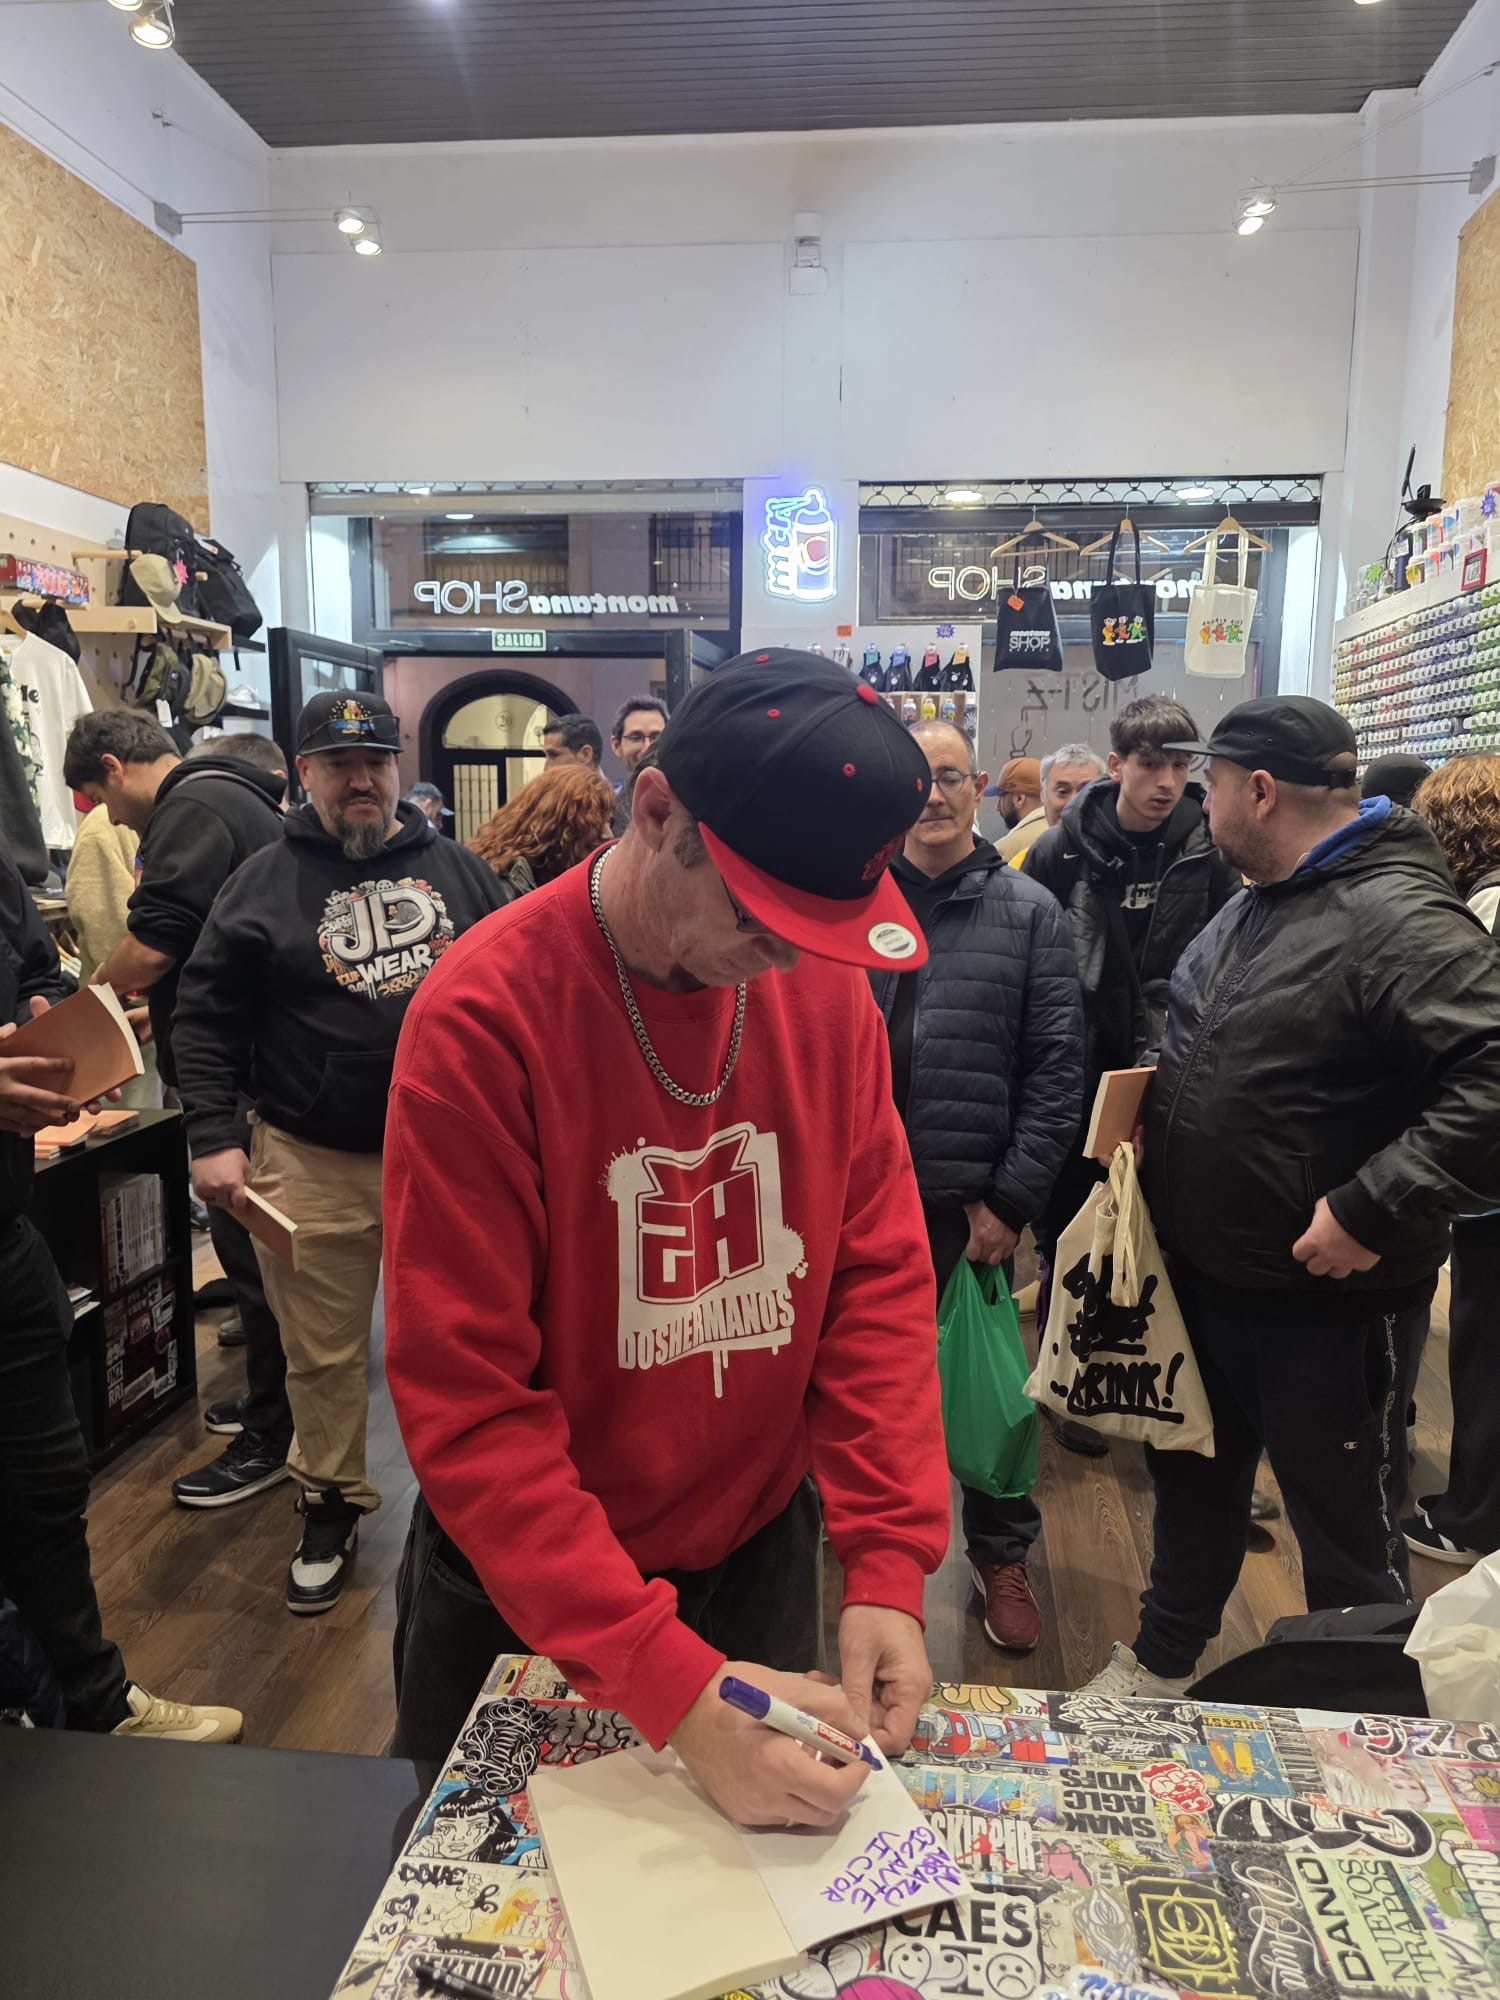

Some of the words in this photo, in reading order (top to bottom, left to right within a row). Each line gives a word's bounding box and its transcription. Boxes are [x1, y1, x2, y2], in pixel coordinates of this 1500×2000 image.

[496, 633, 541, 647] SALIDA
[1009, 636, 1051, 649] SHOP
[356, 943, 434, 986] WEAR
[620, 1286, 796, 1370] DOSHERMANOS
[1058, 1767, 1145, 1791] VDFS
[1063, 1790, 1148, 1814] AGLC
[1064, 1812, 1157, 1839] SNAK
[820, 1831, 900, 1903] VICTOR
[1338, 1858, 1420, 1984] NUEVOS
[1365, 1859, 1446, 1985] TRAPOS
